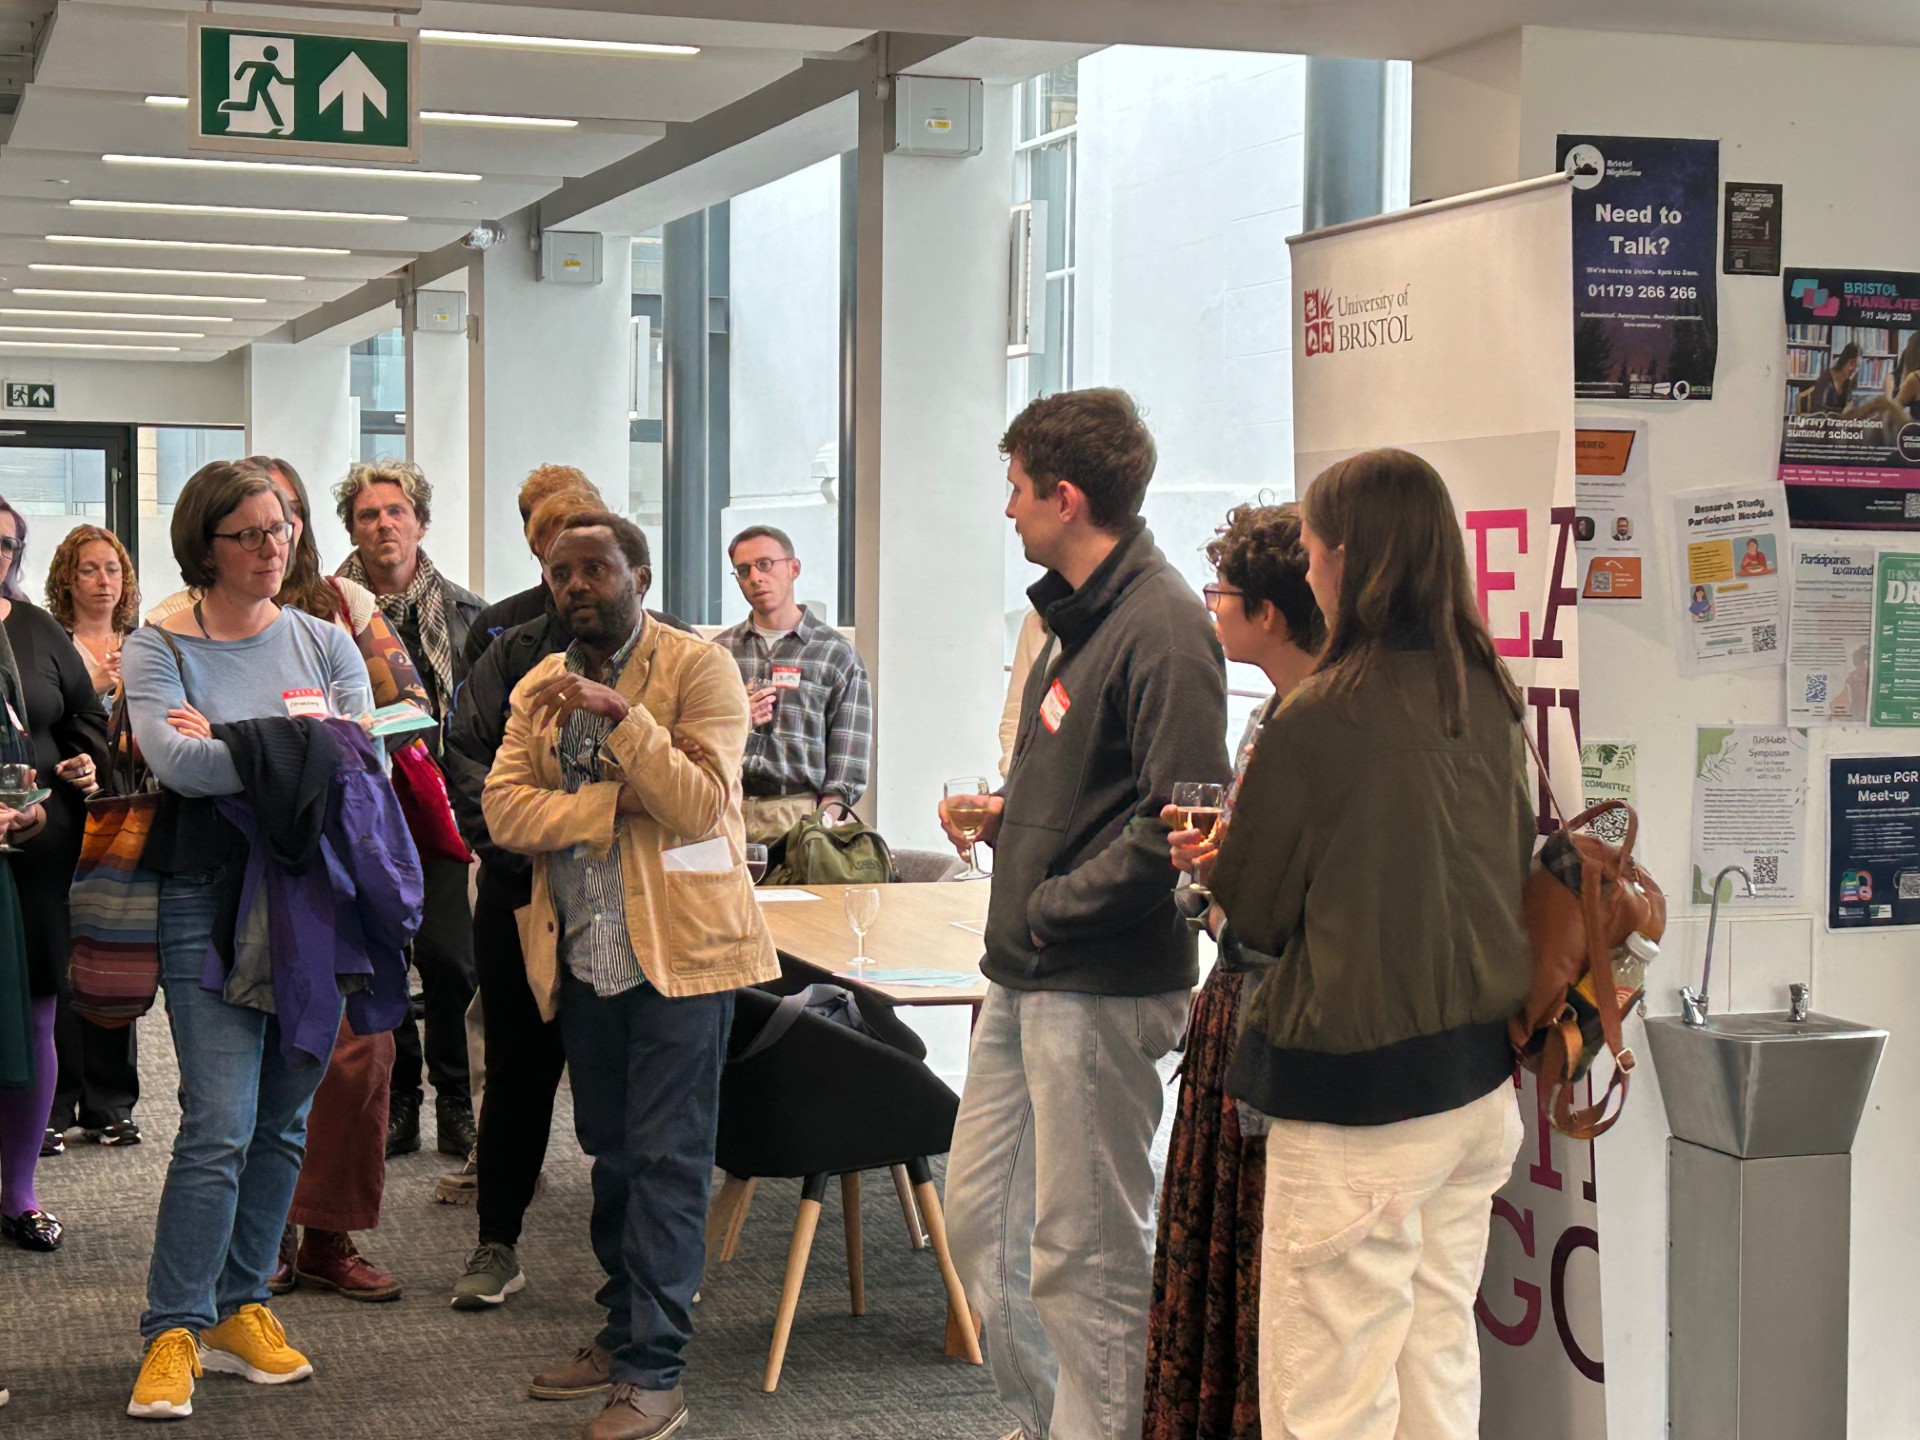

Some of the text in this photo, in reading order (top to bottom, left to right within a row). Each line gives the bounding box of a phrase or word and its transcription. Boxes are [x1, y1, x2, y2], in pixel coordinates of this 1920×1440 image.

[1595, 203, 1682, 224] Need to
[1608, 236, 1670, 255] Talk?
[1588, 284, 1697, 299] 01179 266 266
[1843, 282, 1899, 296] BRISTOL
[1337, 283, 1410, 317] University of
[1338, 315, 1414, 351] BRISTOL
[1827, 417, 1883, 429] translation
[1786, 429, 1864, 440] summer school
[1694, 499, 1765, 514] Research Study
[1688, 509, 1774, 527] Participant Needed
[1800, 553, 1851, 567] Participants
[1832, 565, 1874, 576] wanted
[1847, 771, 1919, 785] Mature PGR
[1584, 780, 1631, 793] COMMITTEE
[1857, 790, 1910, 803] Meet-up
